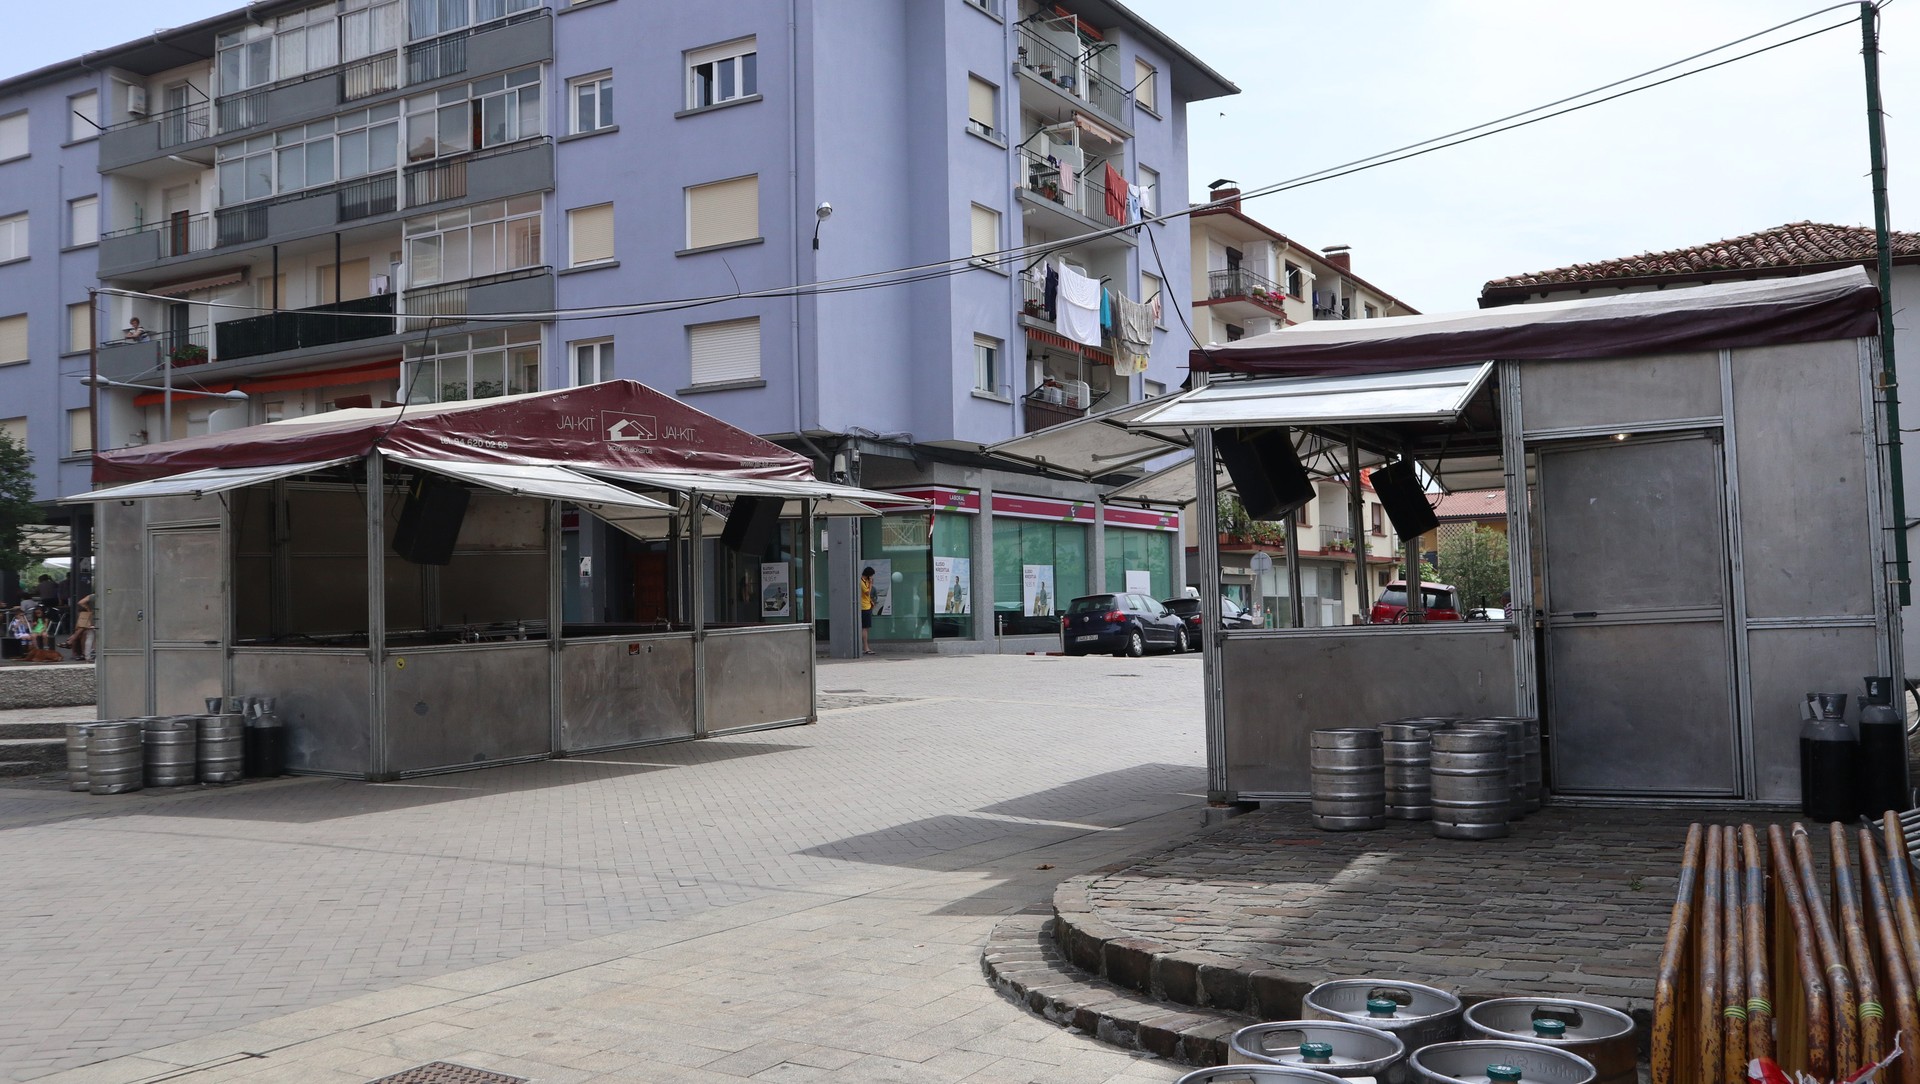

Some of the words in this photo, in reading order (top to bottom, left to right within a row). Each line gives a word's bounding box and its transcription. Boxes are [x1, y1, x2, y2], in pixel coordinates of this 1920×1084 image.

[556, 415, 596, 432] JAI-KIT
[661, 425, 696, 441] JAI-KIT
[467, 438, 484, 448] 620
